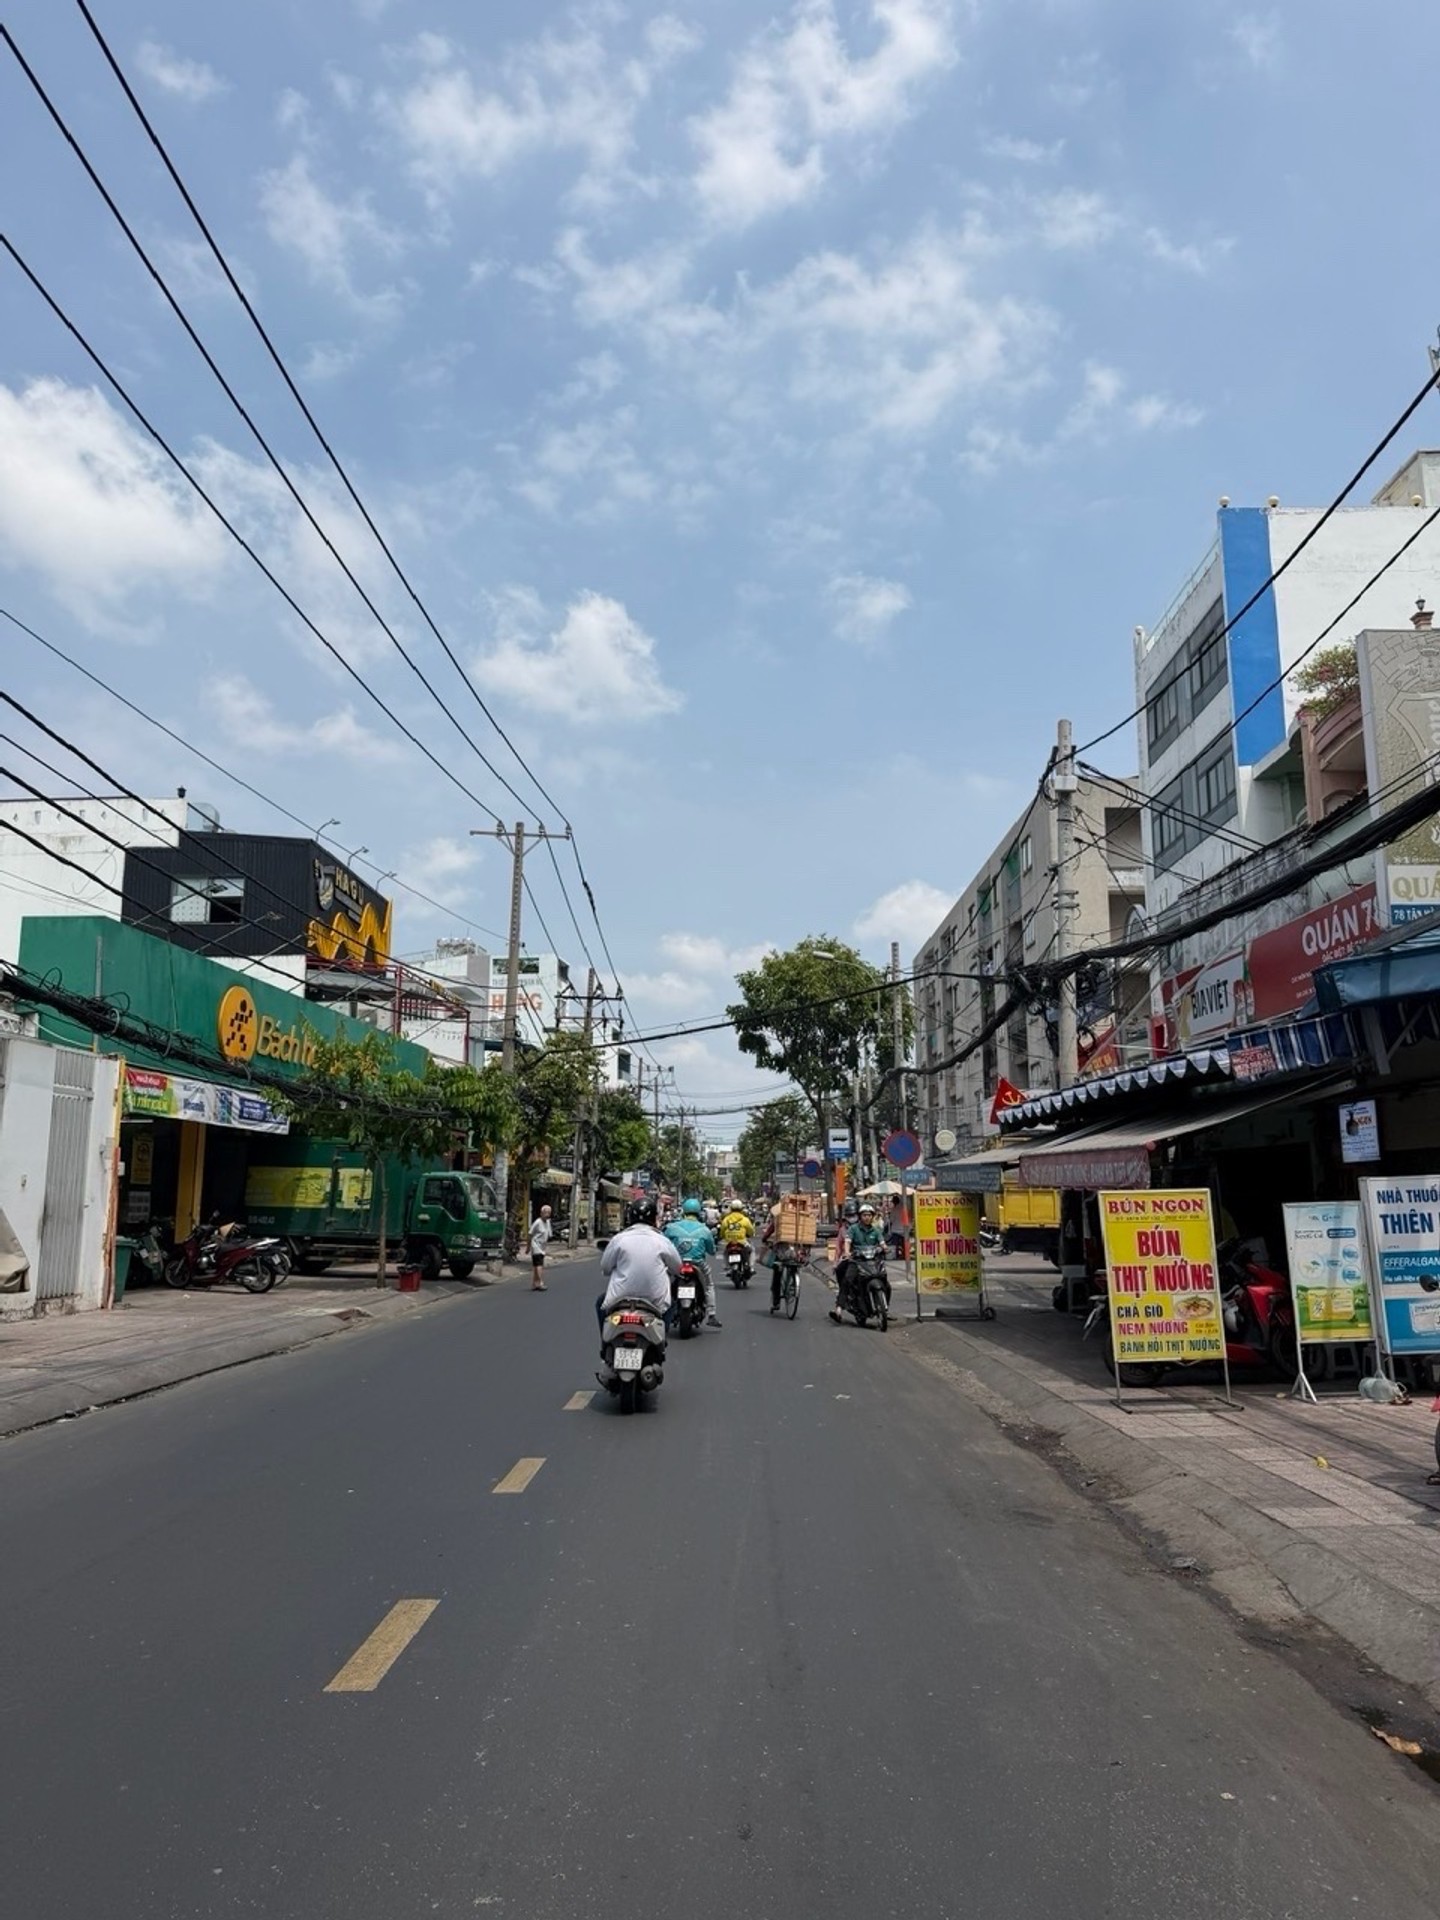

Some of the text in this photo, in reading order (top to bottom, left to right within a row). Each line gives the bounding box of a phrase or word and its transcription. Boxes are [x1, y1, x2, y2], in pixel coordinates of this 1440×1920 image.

[1302, 904, 1359, 956] QUÁN
[1377, 1184, 1440, 1204] NHÀ THUỐ
[1108, 1198, 1204, 1214] BÚN NGON
[936, 1215, 960, 1234] BÚN
[1380, 1209, 1434, 1234] THIÊN
[920, 1240, 940, 1258] THỊT
[1137, 1225, 1181, 1257] BÚN
[1112, 1258, 1214, 1298] THỊT NƯỚNG
[1118, 1323, 1146, 1335] NEM
